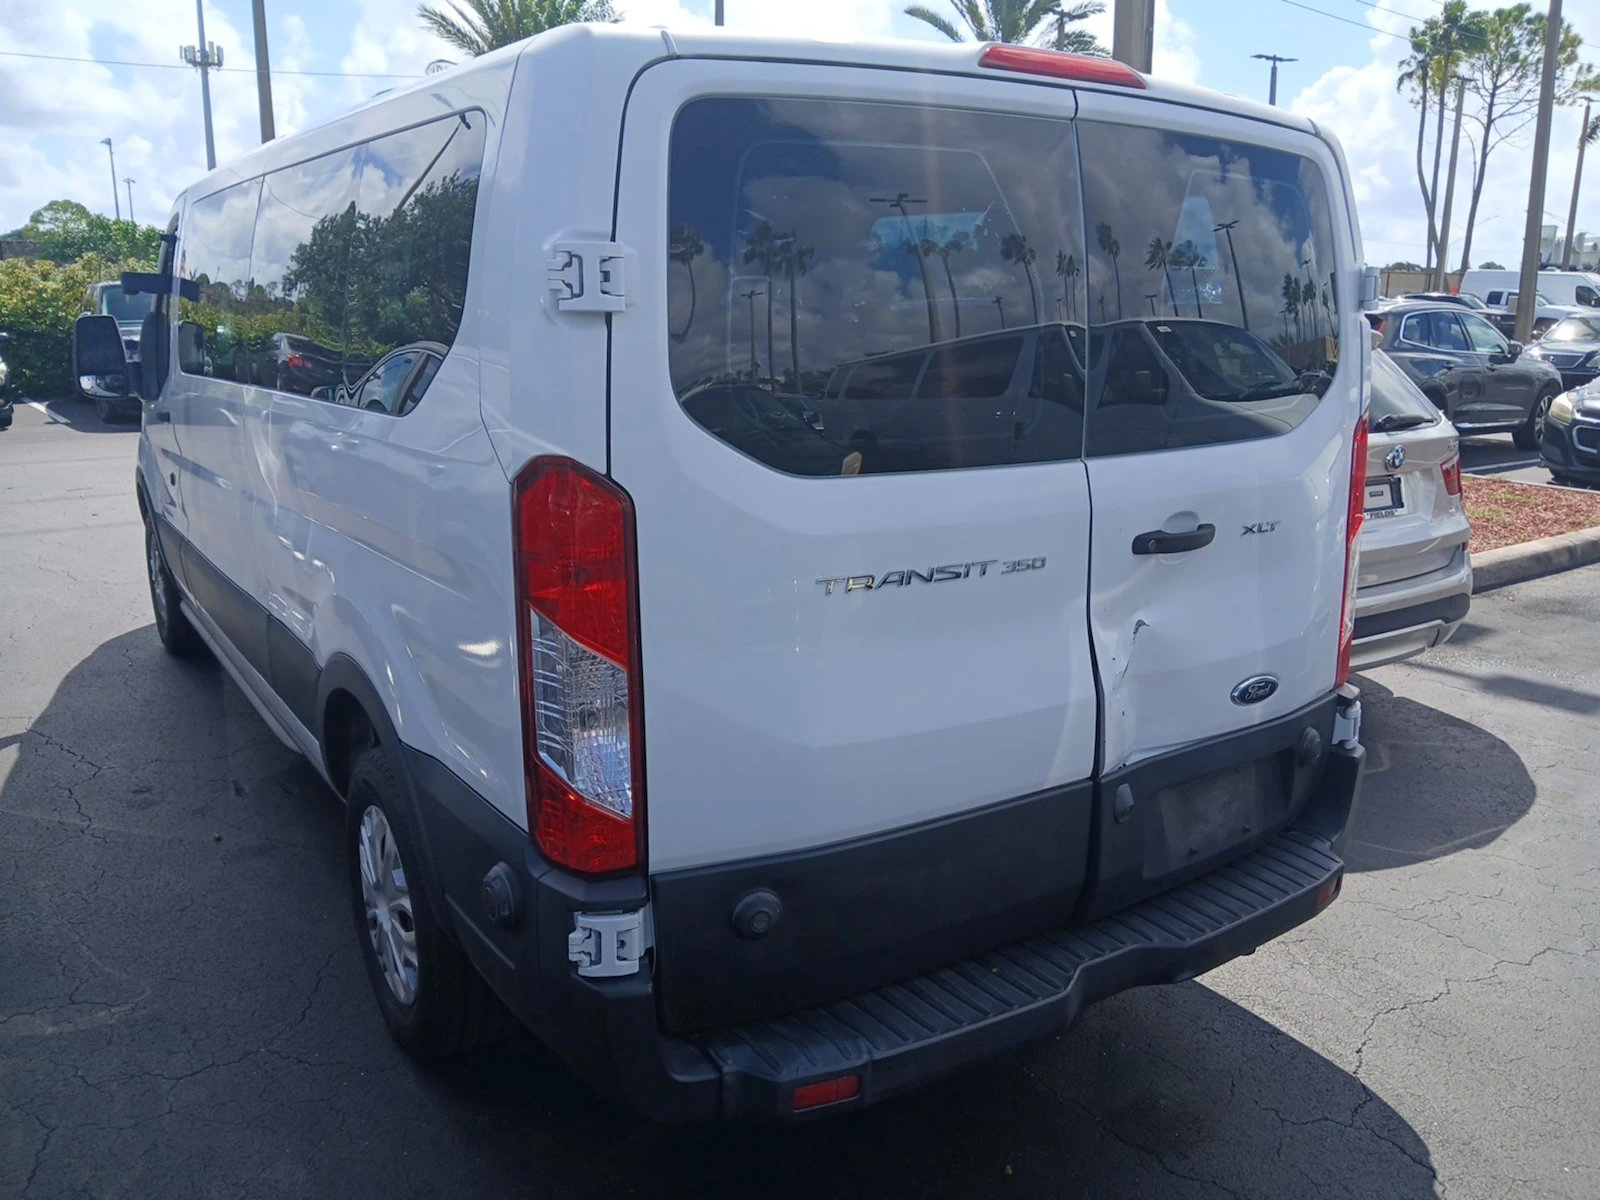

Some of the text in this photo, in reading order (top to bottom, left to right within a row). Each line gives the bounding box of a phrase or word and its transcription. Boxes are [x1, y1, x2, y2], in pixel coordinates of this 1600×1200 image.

[1240, 520, 1281, 536] XLT
[815, 556, 1047, 596] TRANSIT 350
